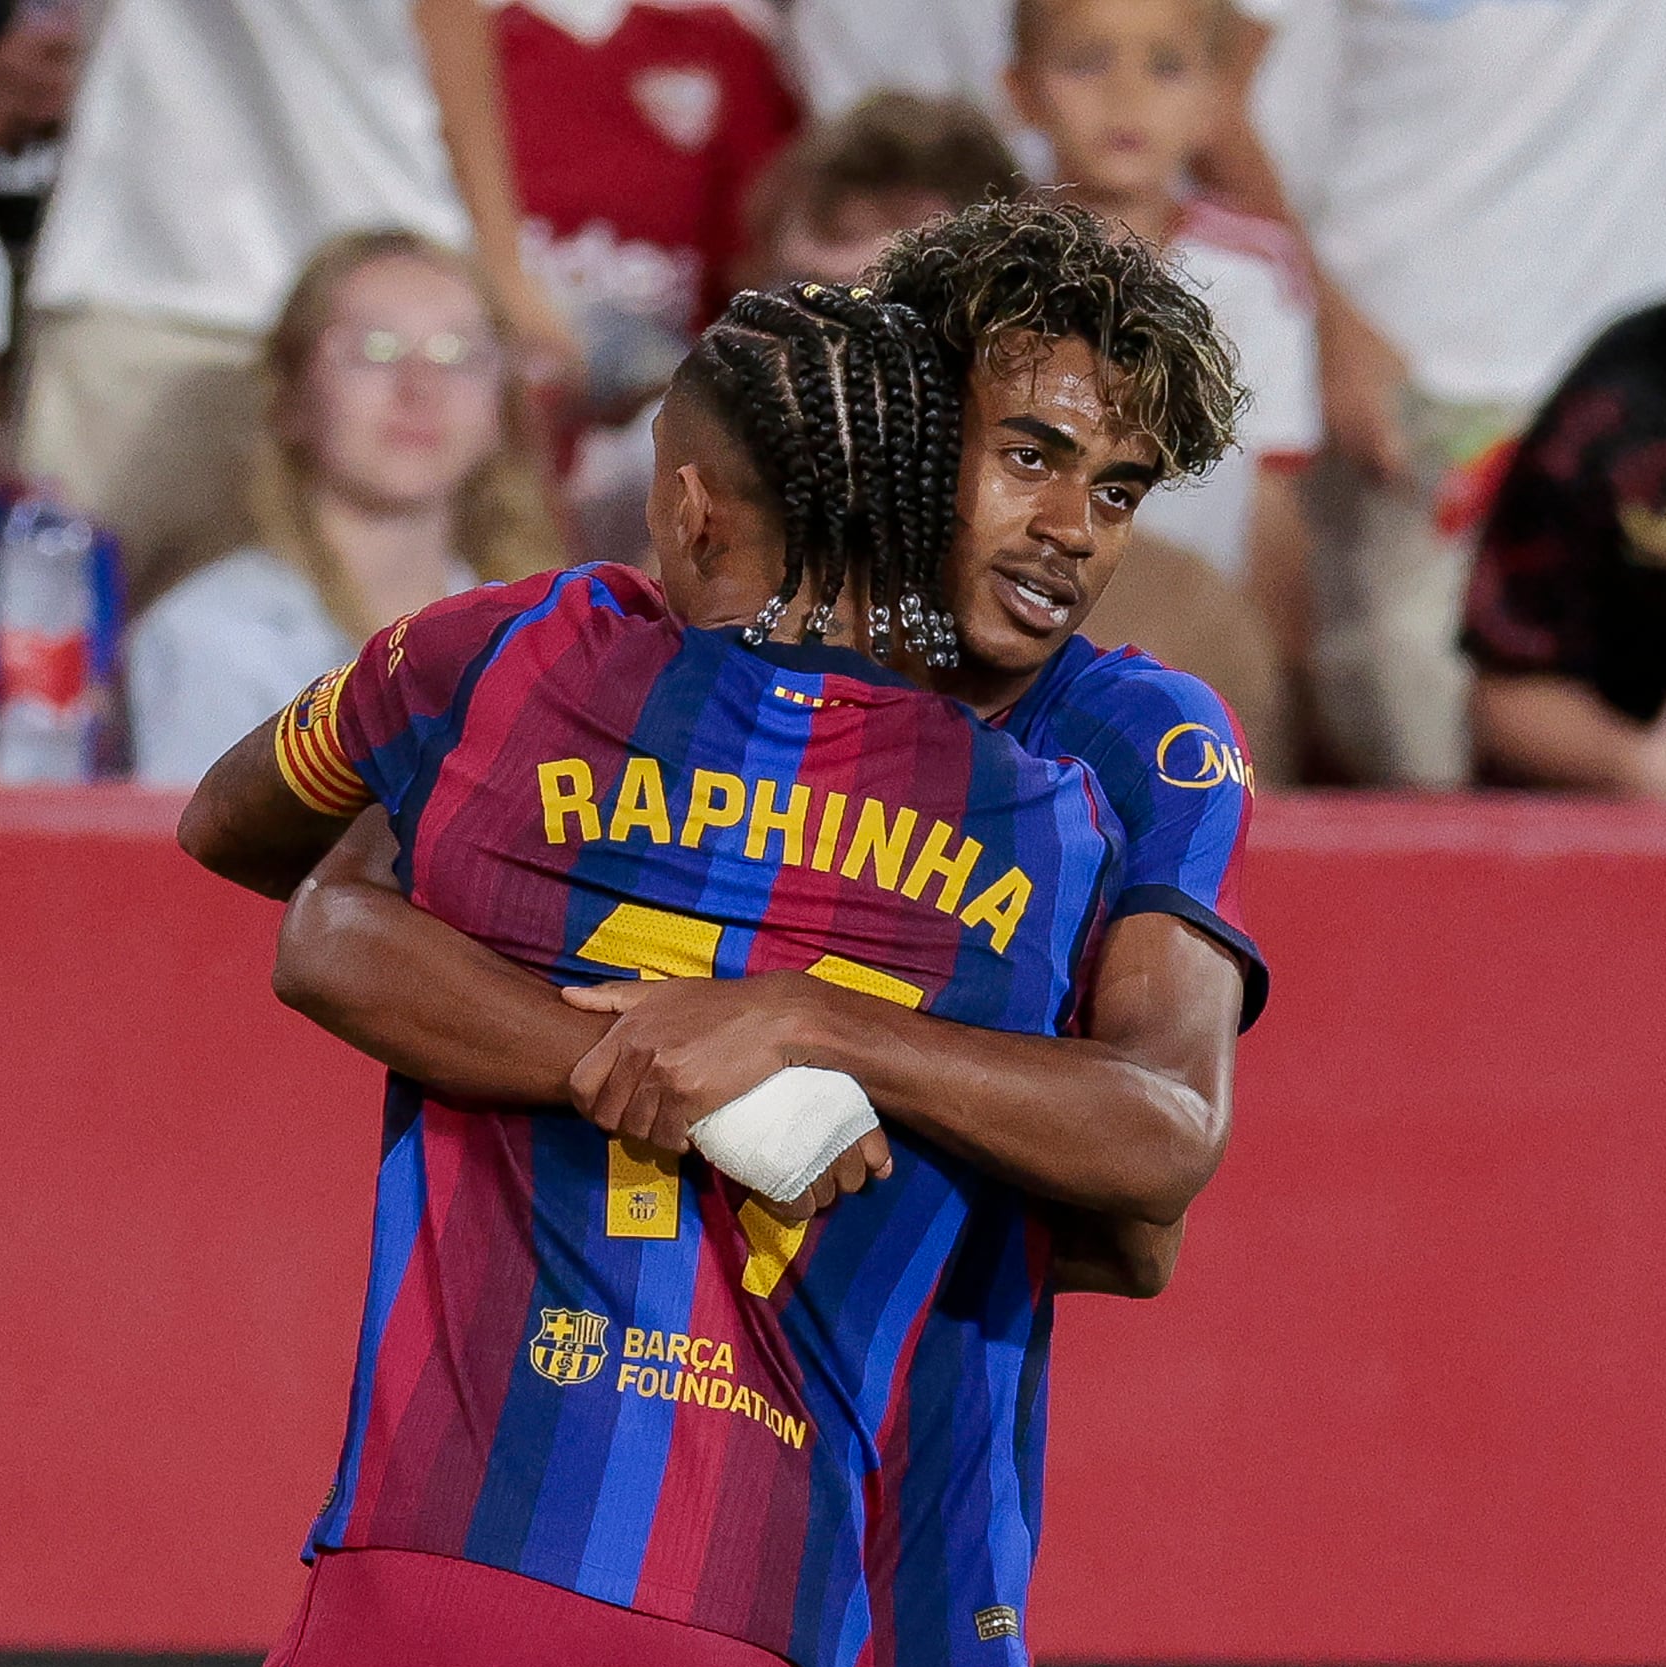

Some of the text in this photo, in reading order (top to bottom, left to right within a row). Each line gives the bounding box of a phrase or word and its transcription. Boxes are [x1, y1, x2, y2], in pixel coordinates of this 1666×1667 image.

[537, 757, 1033, 954] RAPHINHA
[623, 1328, 734, 1374] BARÇA
[616, 1364, 807, 1450] FOUNDATION
